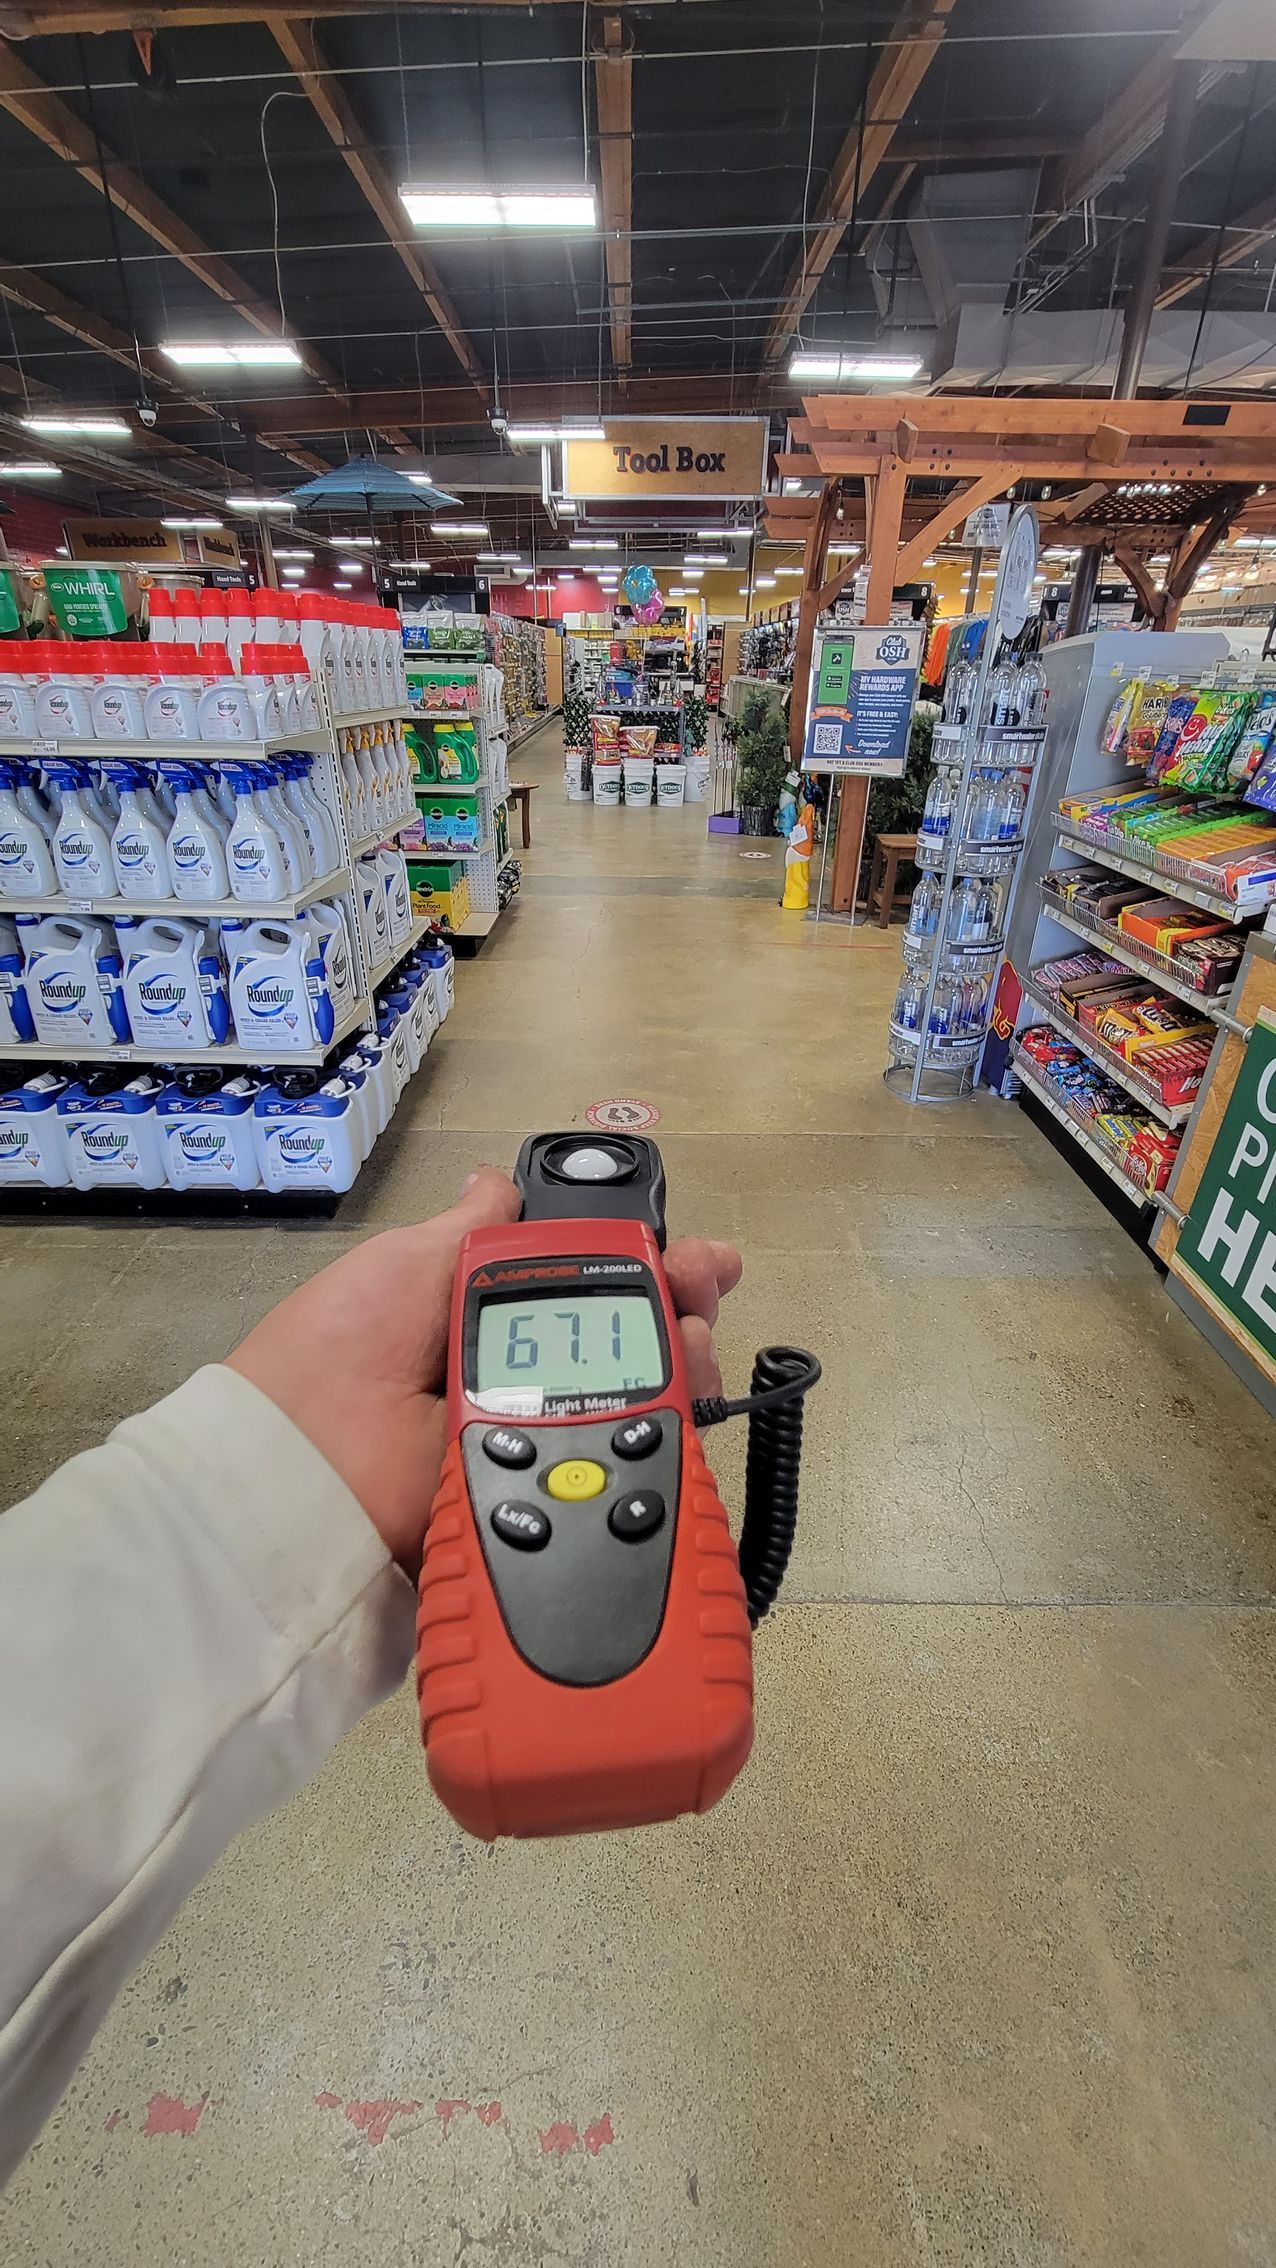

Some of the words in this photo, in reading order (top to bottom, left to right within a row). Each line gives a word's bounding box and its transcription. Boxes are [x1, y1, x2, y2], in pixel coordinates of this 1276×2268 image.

[613, 444, 670, 474] Tool
[676, 446, 726, 473] Box
[82, 531, 167, 549] Workbench
[216, 575, 229, 583] Hand
[229, 575, 242, 583] Tools
[249, 574, 255, 585] 5
[384, 578, 390, 589] 5
[478, 579, 485, 590] 6
[64, 582, 116, 595] WHIRL
[920, 586, 928, 597] 8
[1051, 587, 1058, 597] 8
[886, 637, 902, 646] Club
[879, 646, 907, 658] OSH
[859, 683, 890, 691] REWARDS
[890, 684, 904, 692] APP
[860, 675, 871, 683] MY
[871, 676, 907, 684] HARDWARE
[996, 688, 1010, 725] smart
[1198, 724, 1223, 740] AIR
[857, 739, 890, 748] Download
[864, 748, 881, 756] now!
[0, 843, 28, 858] oundup
[59, 840, 93, 858] Roundup
[116, 841, 150, 859] Roundup
[172, 842, 206, 860] Roundup
[232, 845, 265, 864] Roundup
[39, 980, 87, 1003] Roundup
[139, 982, 187, 1005] Roundup
[247, 984, 294, 1008] Roundup
[1179, 1076, 1202, 1093] Ho
[80, 1131, 129, 1151] Roundup
[181, 1131, 227, 1153] Roundup
[278, 1133, 326, 1155] Roundup
[494, 1265, 580, 1281] AMPROBE
[583, 1264, 643, 1275] LM-200LED
[506, 1310, 621, 1370] 67.1
[543, 1399, 581, 1413] Light
[584, 1396, 627, 1409] Meter
[624, 1421, 651, 1444] D-H
[491, 1432, 523, 1453] M-H
[498, 1503, 541, 1535] Lx/Fc
